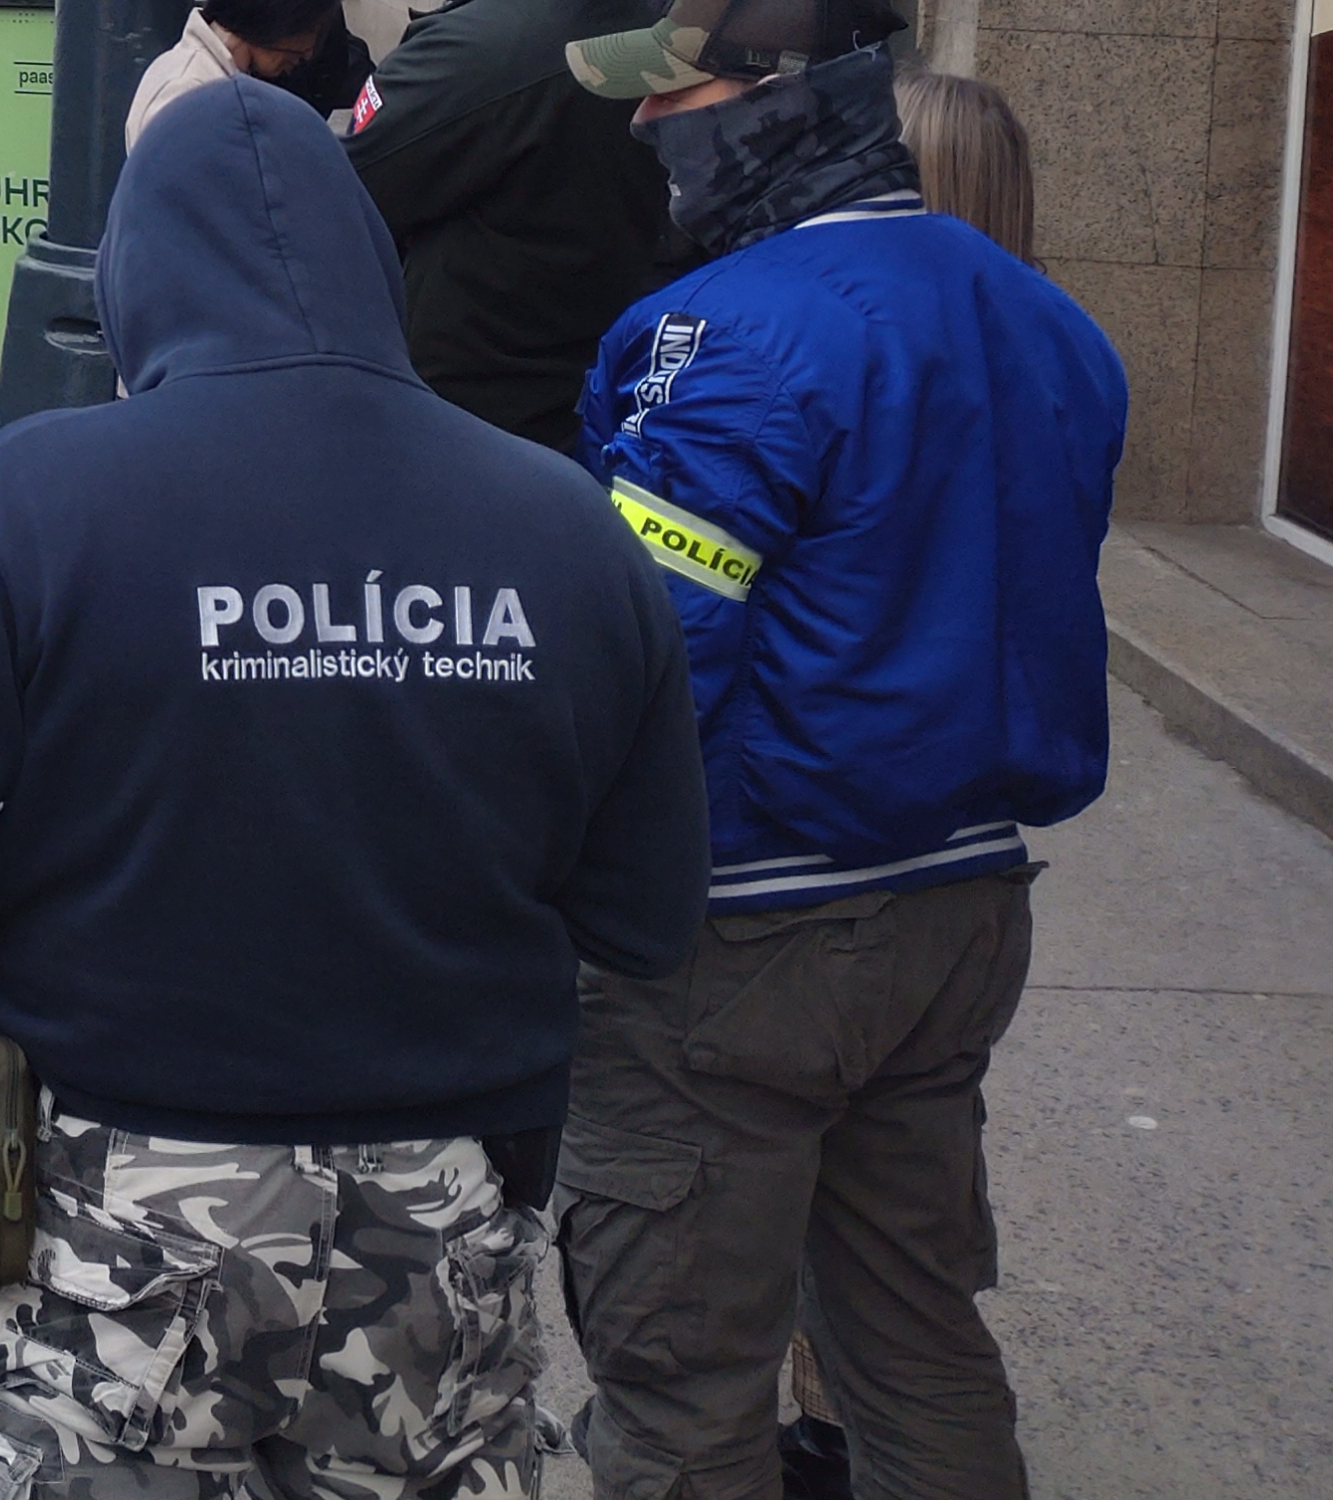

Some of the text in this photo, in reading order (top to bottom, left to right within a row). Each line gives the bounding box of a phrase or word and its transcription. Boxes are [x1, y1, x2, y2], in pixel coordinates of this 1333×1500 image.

[197, 569, 536, 647] POLÍCIA
[201, 648, 536, 683] kriminalistický technik
